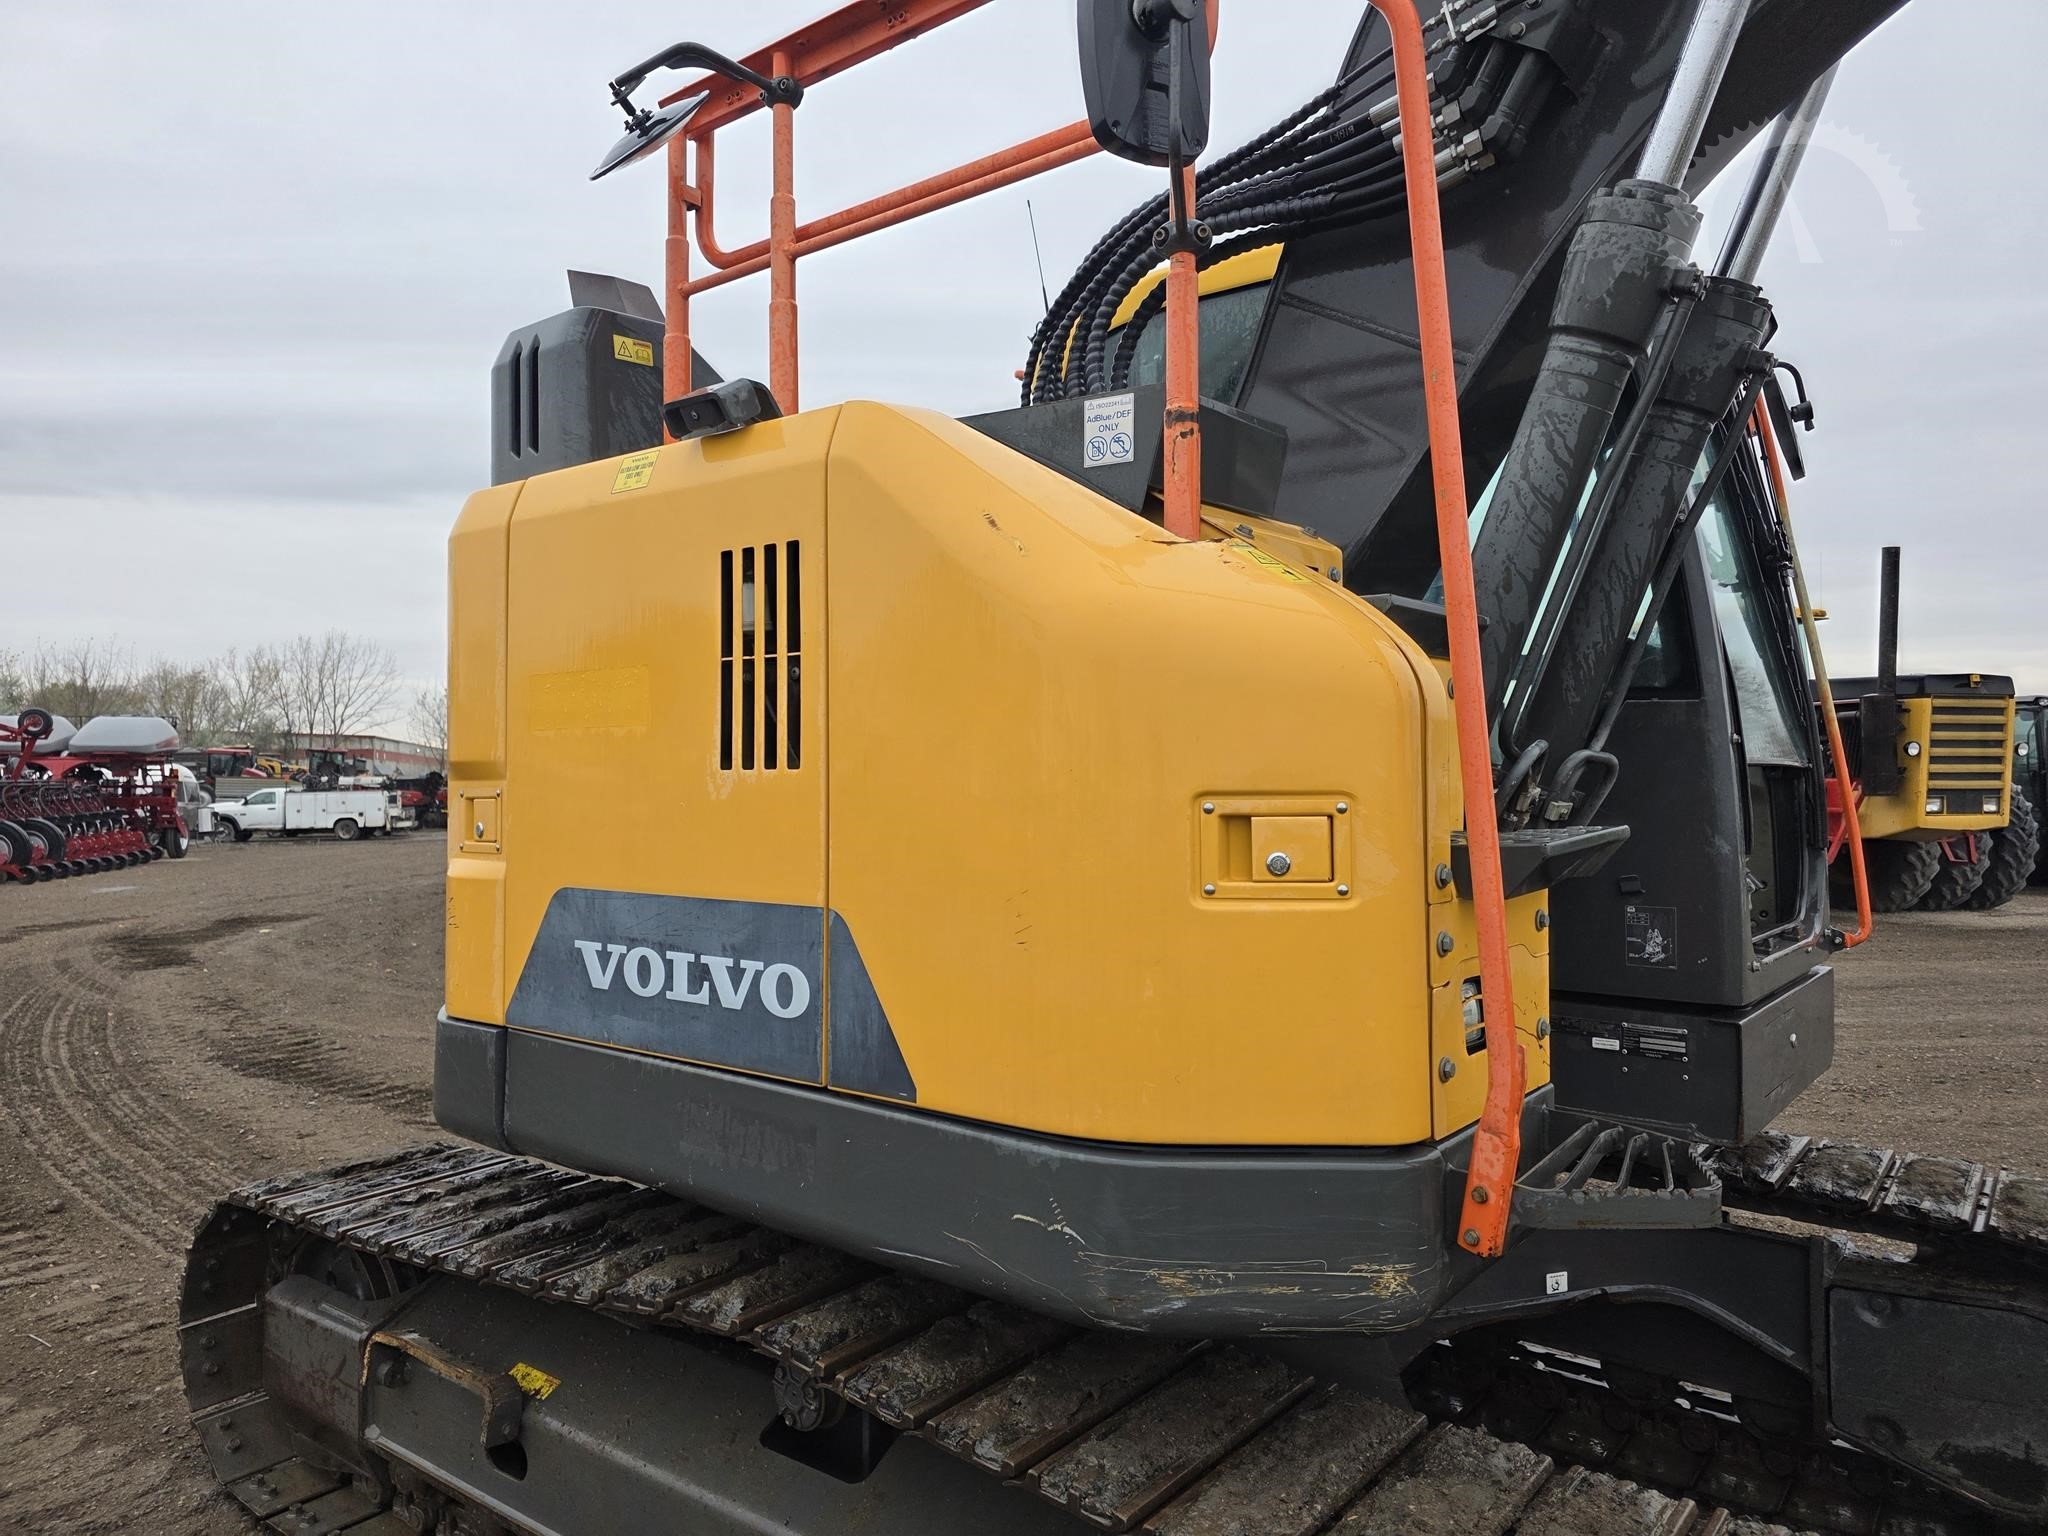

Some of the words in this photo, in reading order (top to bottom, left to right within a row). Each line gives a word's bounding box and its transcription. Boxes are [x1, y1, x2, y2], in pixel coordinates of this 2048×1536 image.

[1086, 409, 1132, 423] AdBlue/DEF
[1098, 422, 1119, 432] ONLY
[574, 939, 810, 1019] VOLVO
